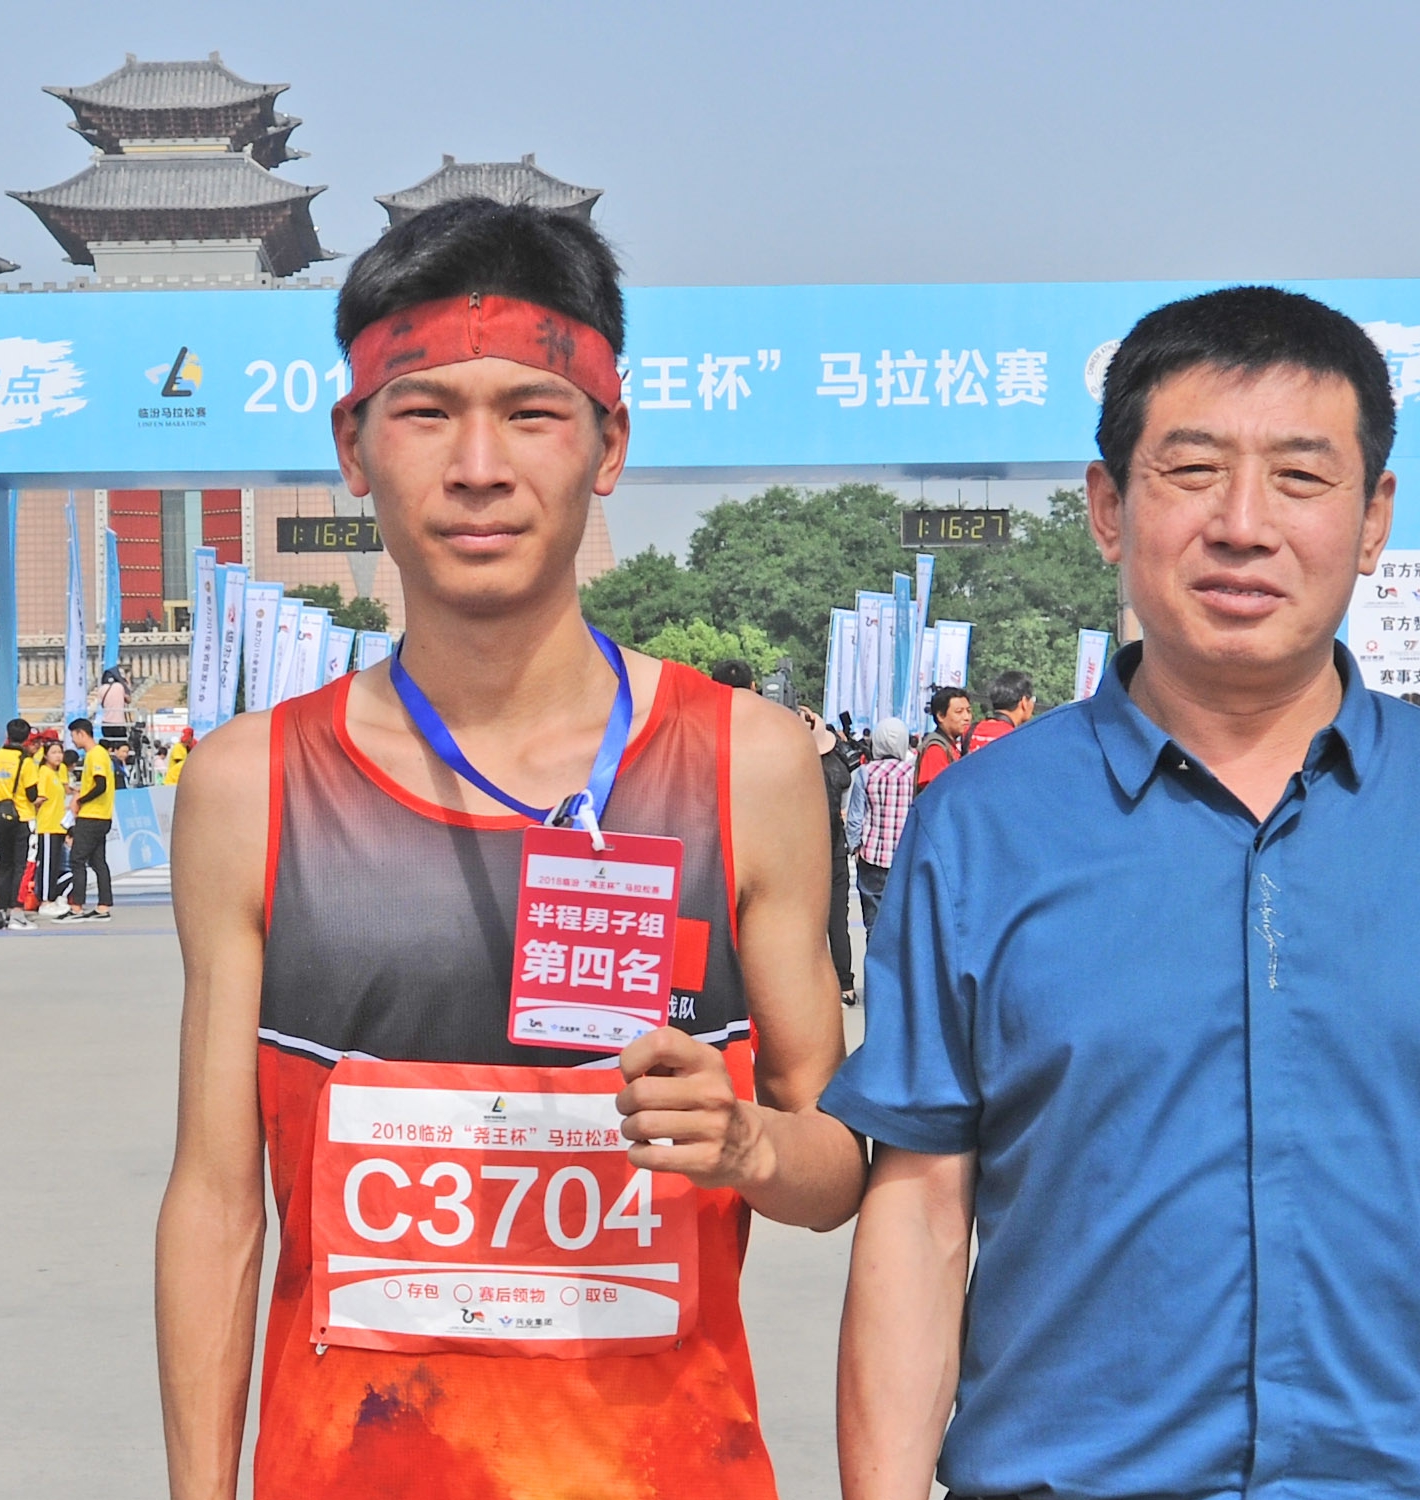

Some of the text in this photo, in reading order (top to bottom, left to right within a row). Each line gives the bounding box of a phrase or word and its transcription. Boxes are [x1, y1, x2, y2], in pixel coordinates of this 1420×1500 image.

[137, 407, 207, 419] 临汾马拉松赛
[293, 523, 378, 546] 1:16:27
[917, 515, 1004, 539] 1:16:27
[527, 902, 665, 939] 半程男子组
[520, 939, 661, 995] 第四名
[371, 1122, 620, 1147] 2018临汾“尧王杯”马拉松赛
[343, 1158, 662, 1251] C3704
[407, 1282, 439, 1300] 存包
[479, 1286, 546, 1304] 赛后领物
[585, 1287, 618, 1303] 取包
